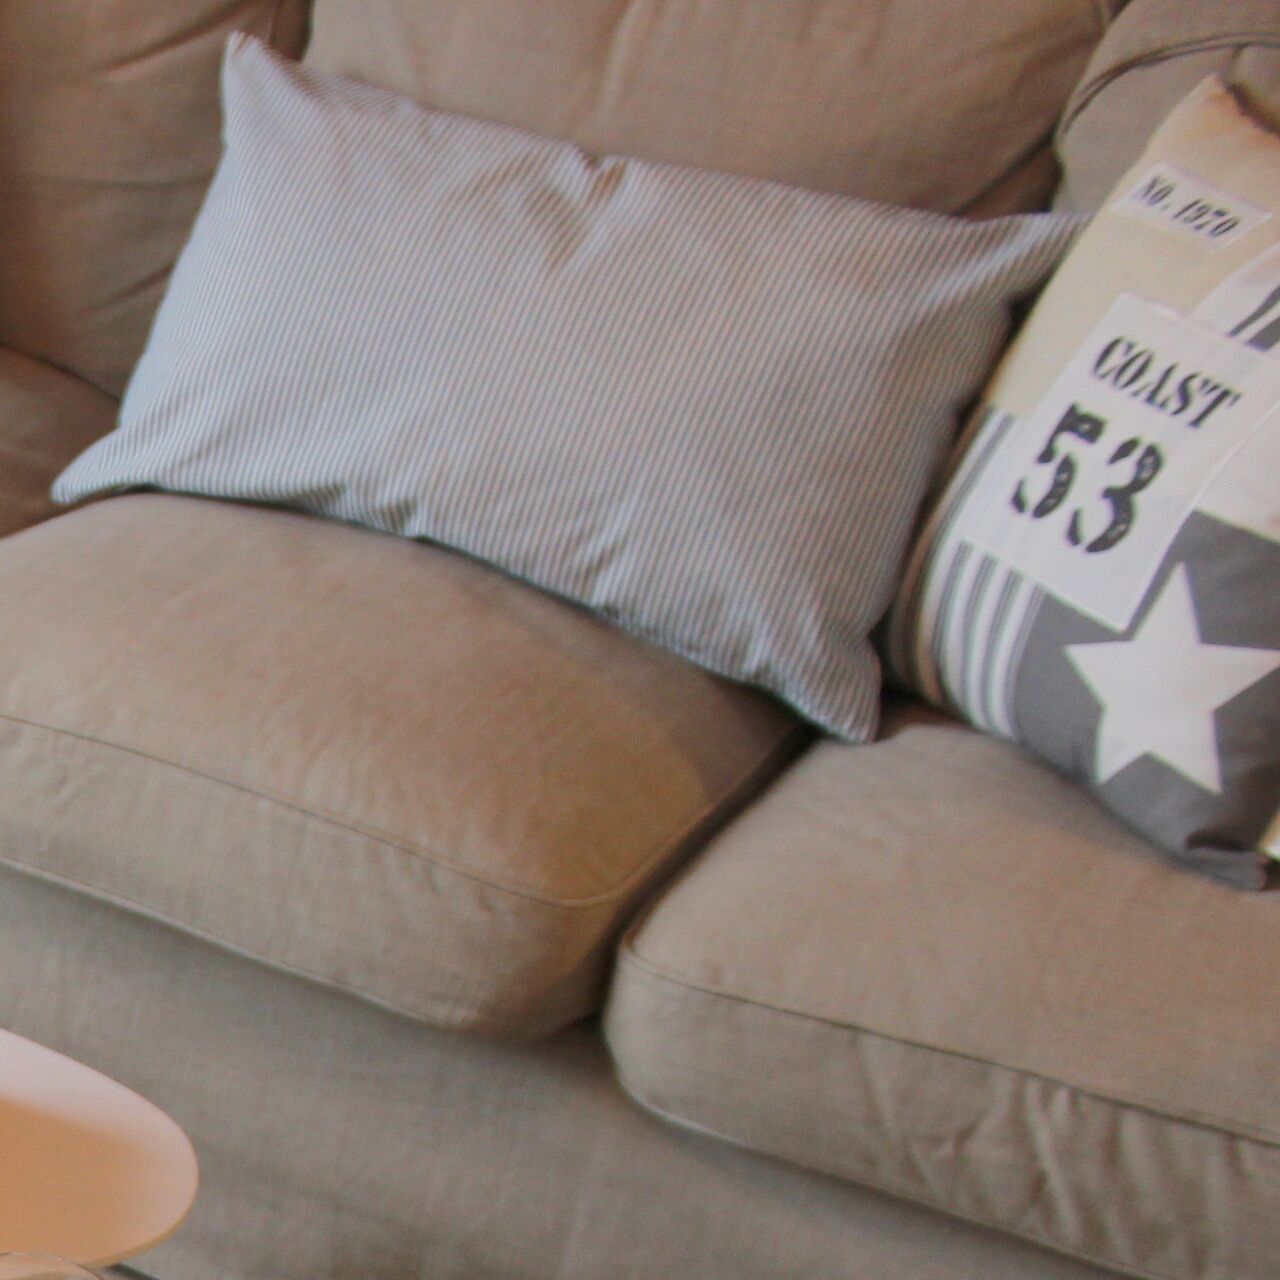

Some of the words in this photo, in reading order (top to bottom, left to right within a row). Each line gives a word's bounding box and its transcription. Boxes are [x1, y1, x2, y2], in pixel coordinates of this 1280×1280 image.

[1172, 198, 1241, 238] 1970
[1093, 335, 1243, 429] COAST
[1011, 401, 1163, 554] 53
